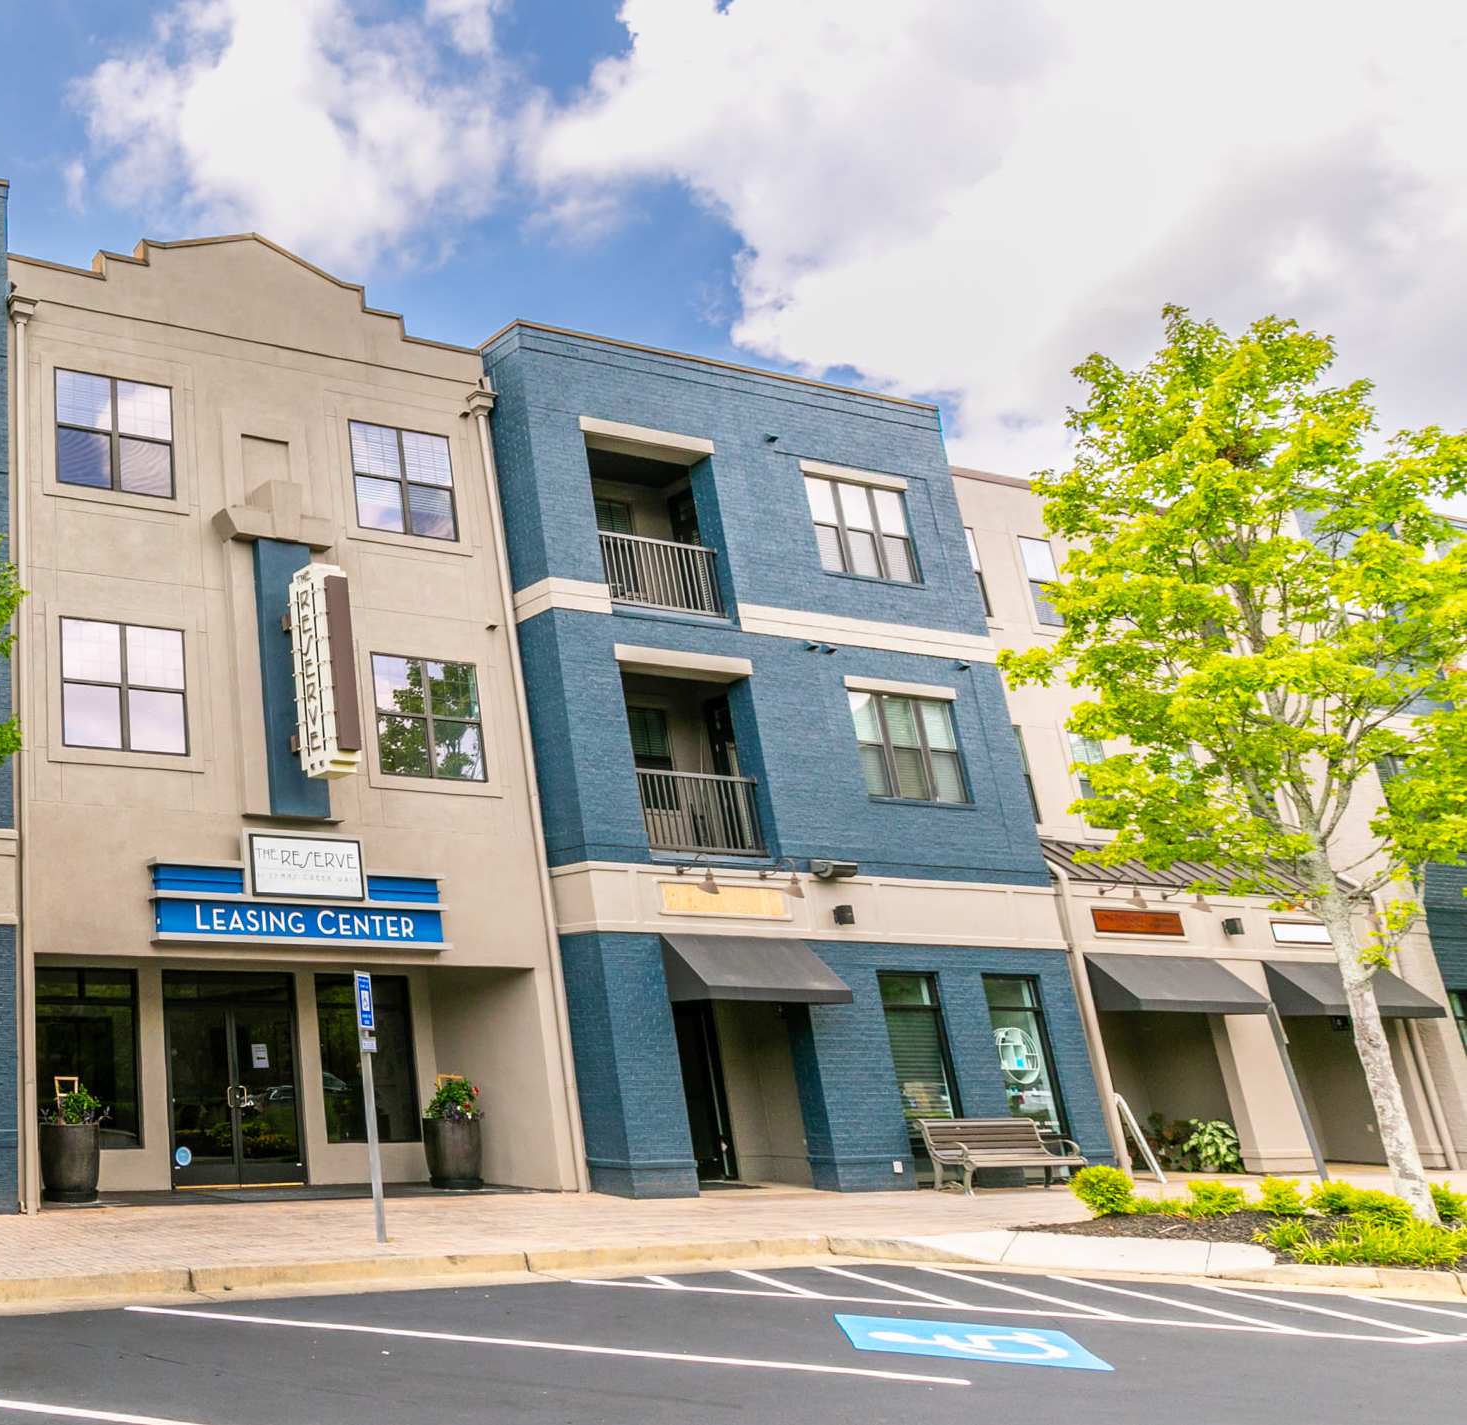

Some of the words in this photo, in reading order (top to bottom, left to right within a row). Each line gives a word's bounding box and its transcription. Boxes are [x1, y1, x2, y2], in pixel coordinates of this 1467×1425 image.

[296, 570, 311, 585] THE
[299, 590, 321, 751] RESERVE
[255, 847, 278, 861] THE
[280, 849, 357, 869] RESERVE
